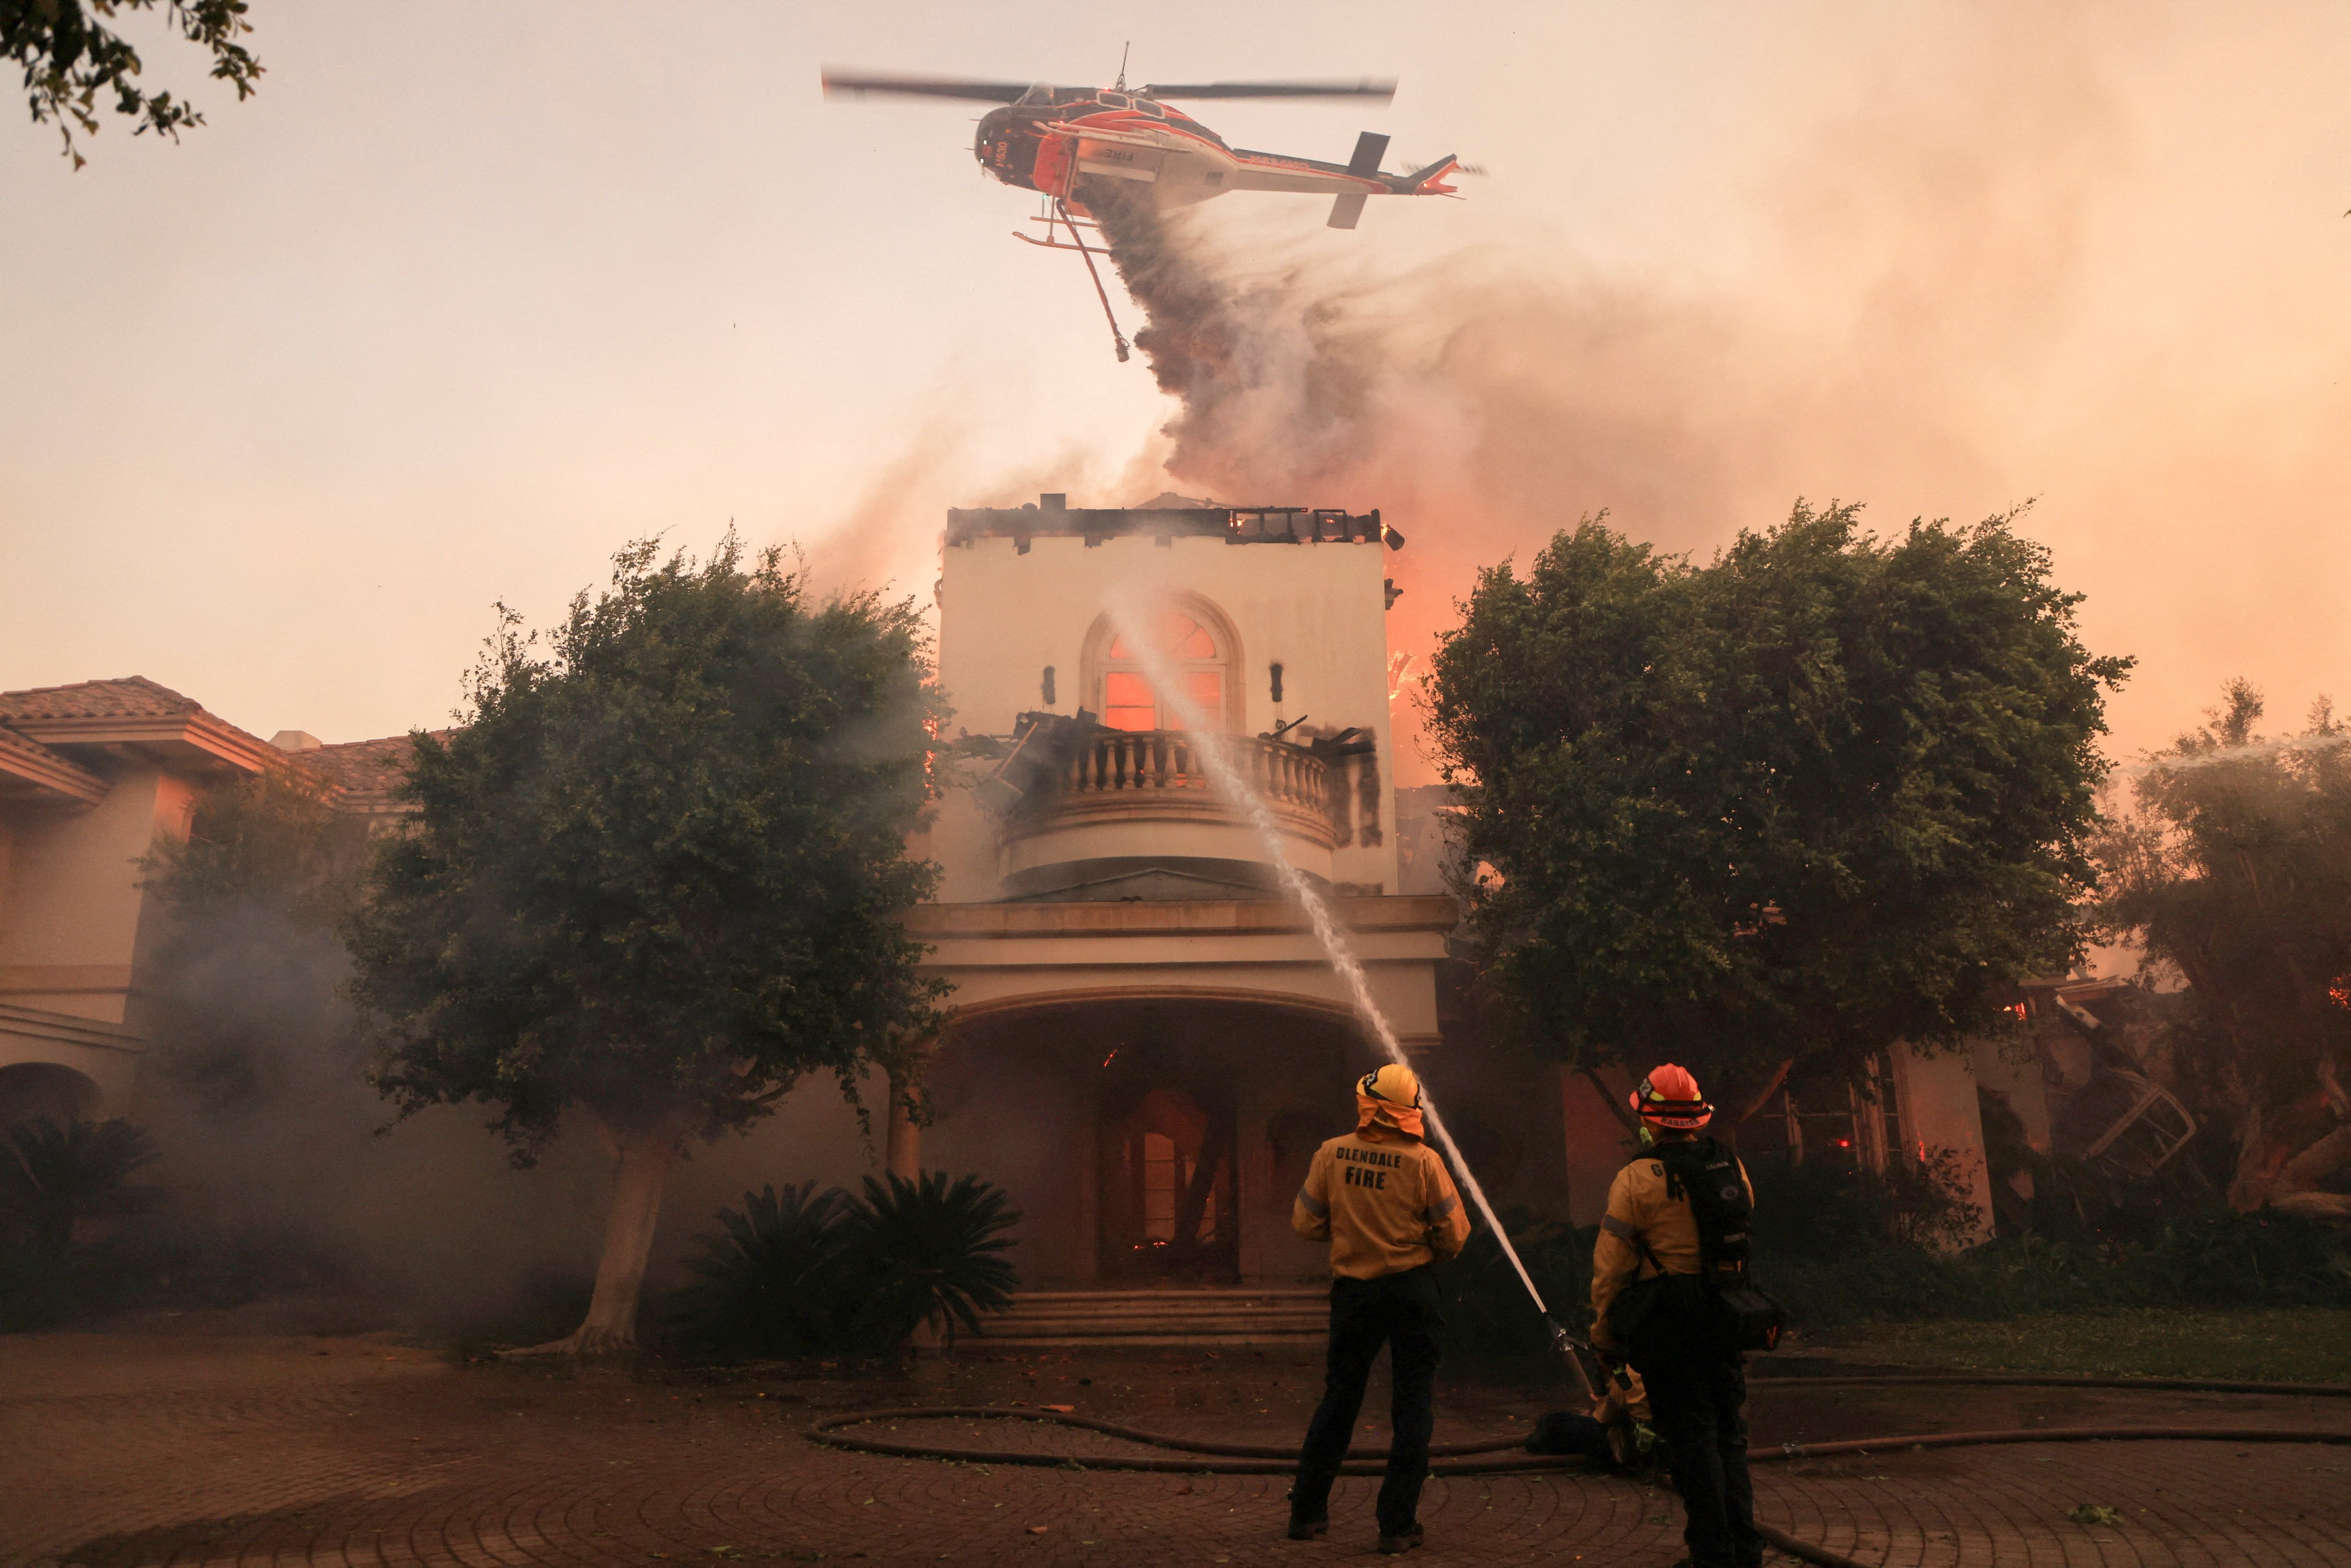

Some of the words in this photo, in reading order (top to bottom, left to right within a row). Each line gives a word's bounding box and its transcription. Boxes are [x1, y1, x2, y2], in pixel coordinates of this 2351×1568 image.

[1104, 148, 1133, 161] FIRE
[1337, 1147, 1401, 1168] GLENDALE
[1346, 1166, 1385, 1190] FIRE
